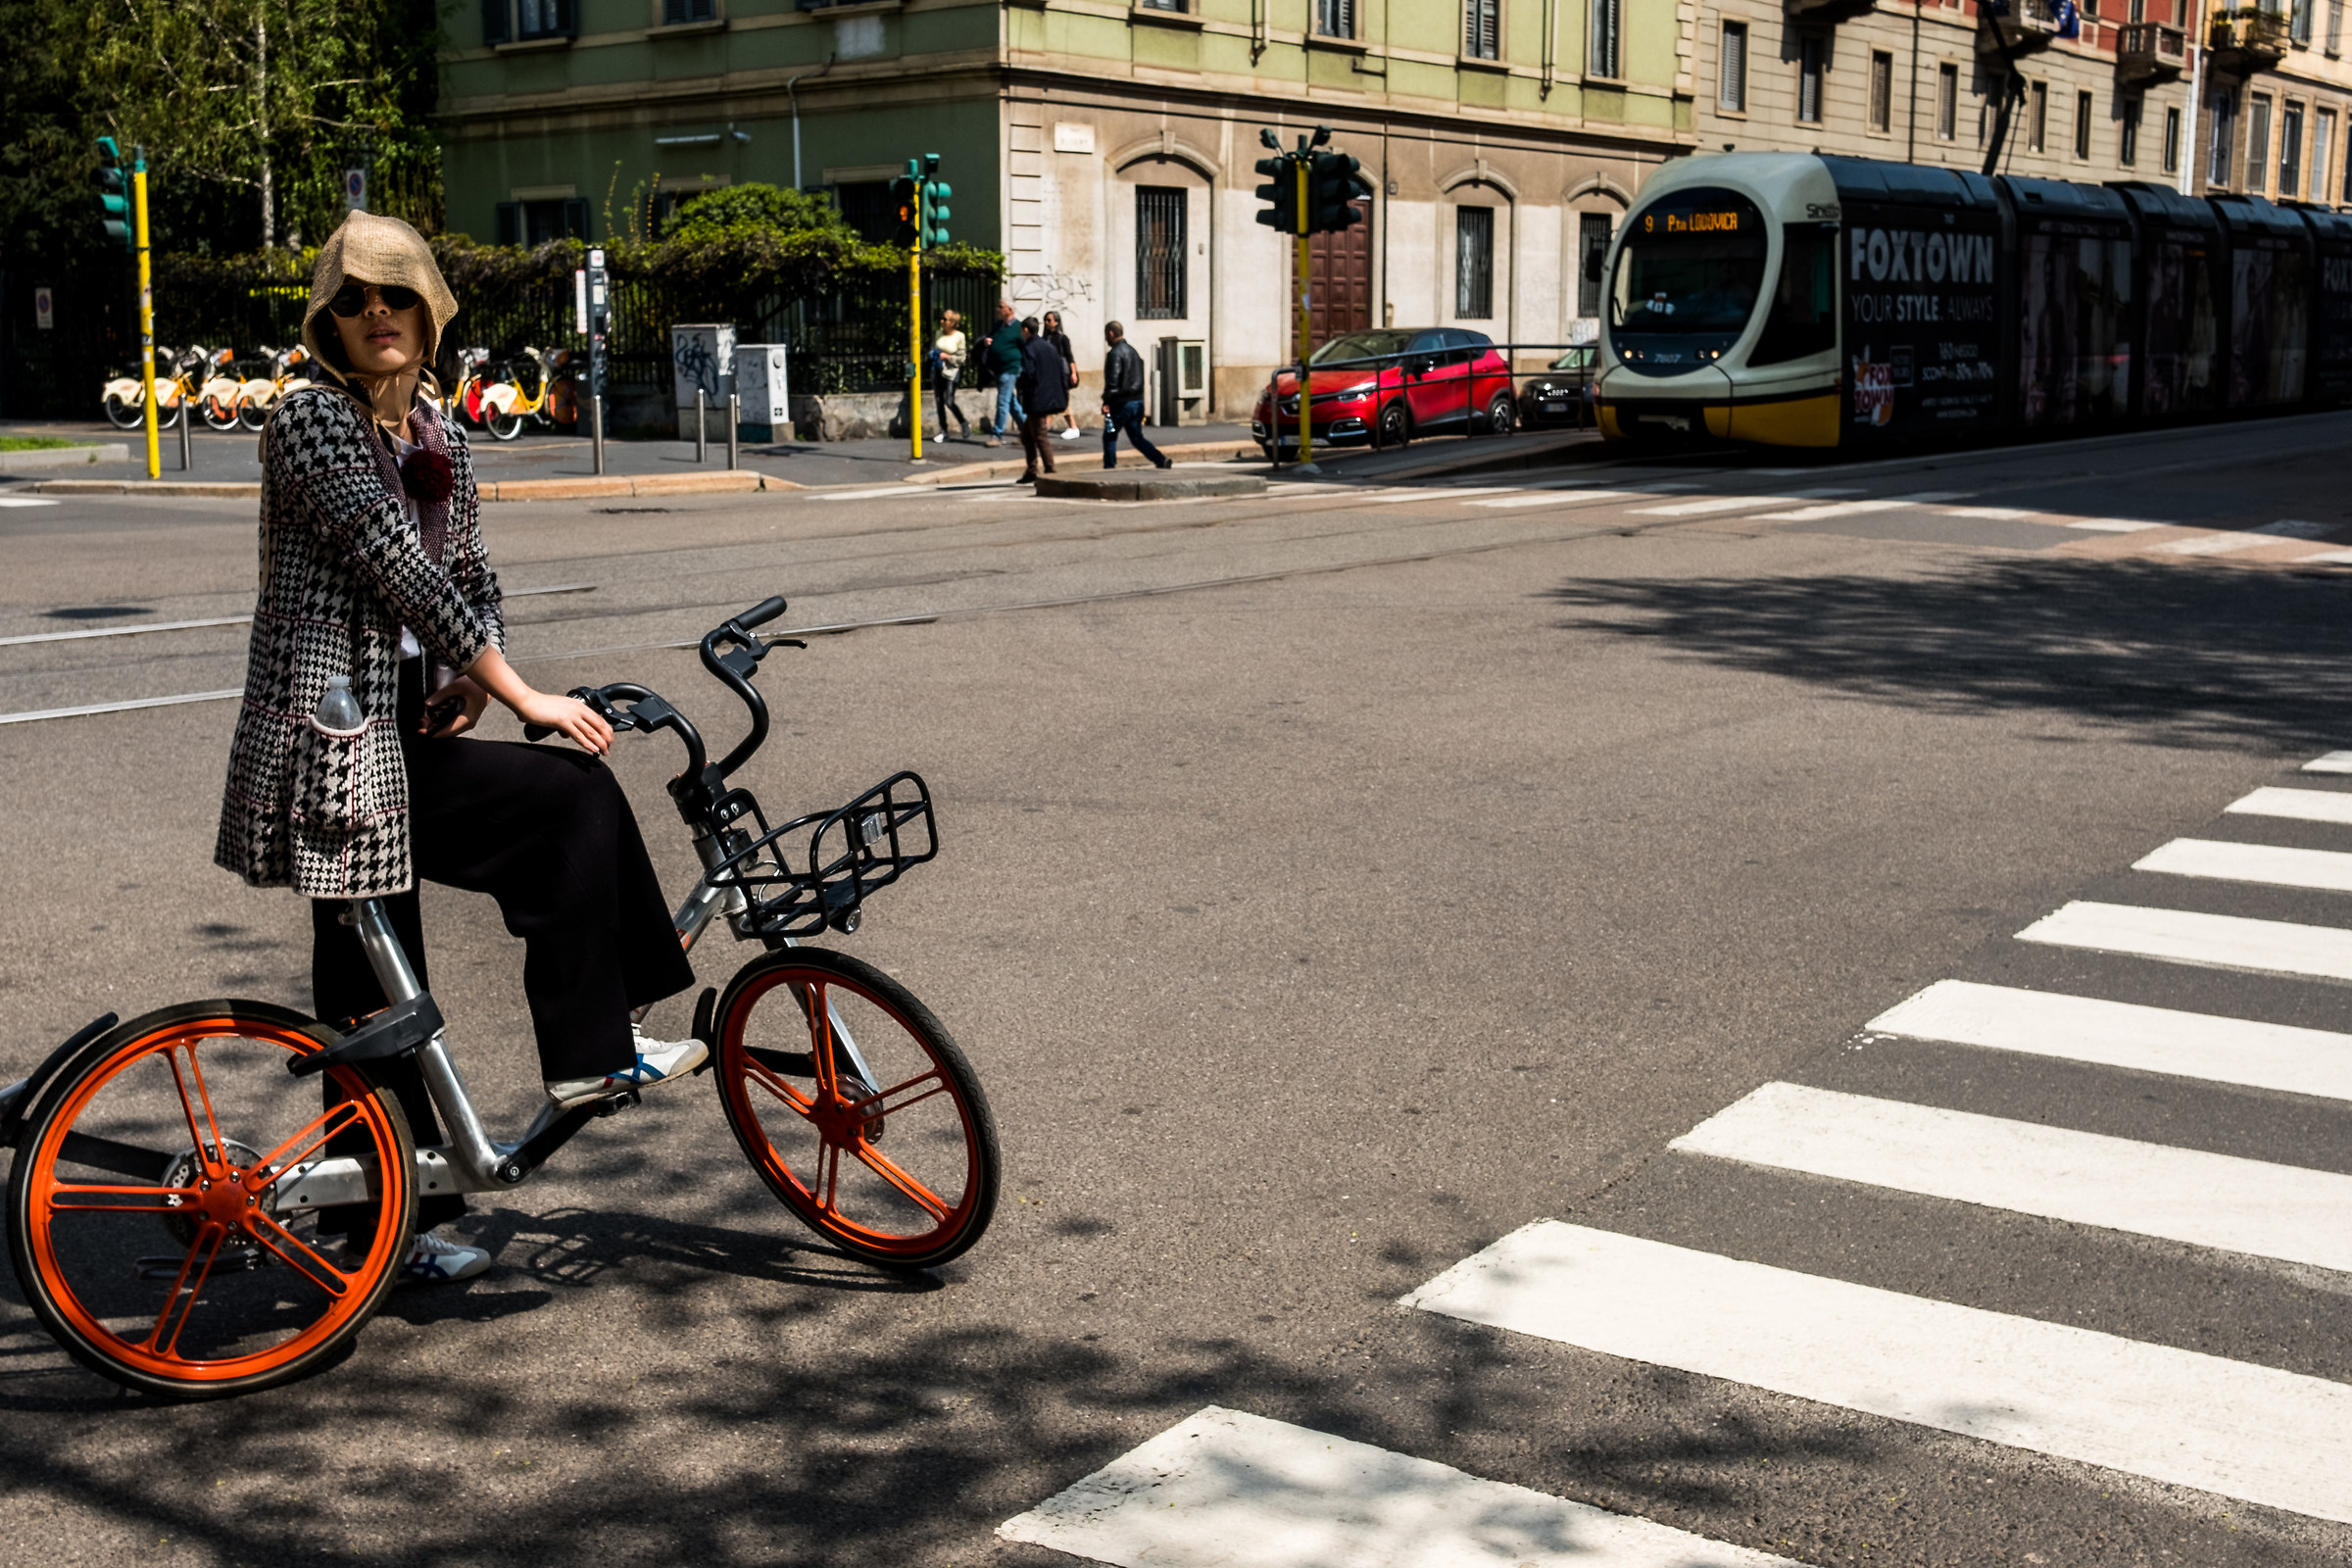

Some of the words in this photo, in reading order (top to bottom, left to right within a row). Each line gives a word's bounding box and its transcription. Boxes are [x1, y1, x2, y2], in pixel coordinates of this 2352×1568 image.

[1644, 215, 1653, 233] 9
[1689, 212, 1739, 232] LODOVICA
[1850, 227, 1993, 284] FOXTOWN
[1851, 294, 1892, 323] YOUR
[1896, 294, 1944, 322] STYLE.
[1947, 294, 1993, 322] ALWAYS
[1869, 363, 1892, 387] FOX
[1854, 389, 1894, 411] TOWN
